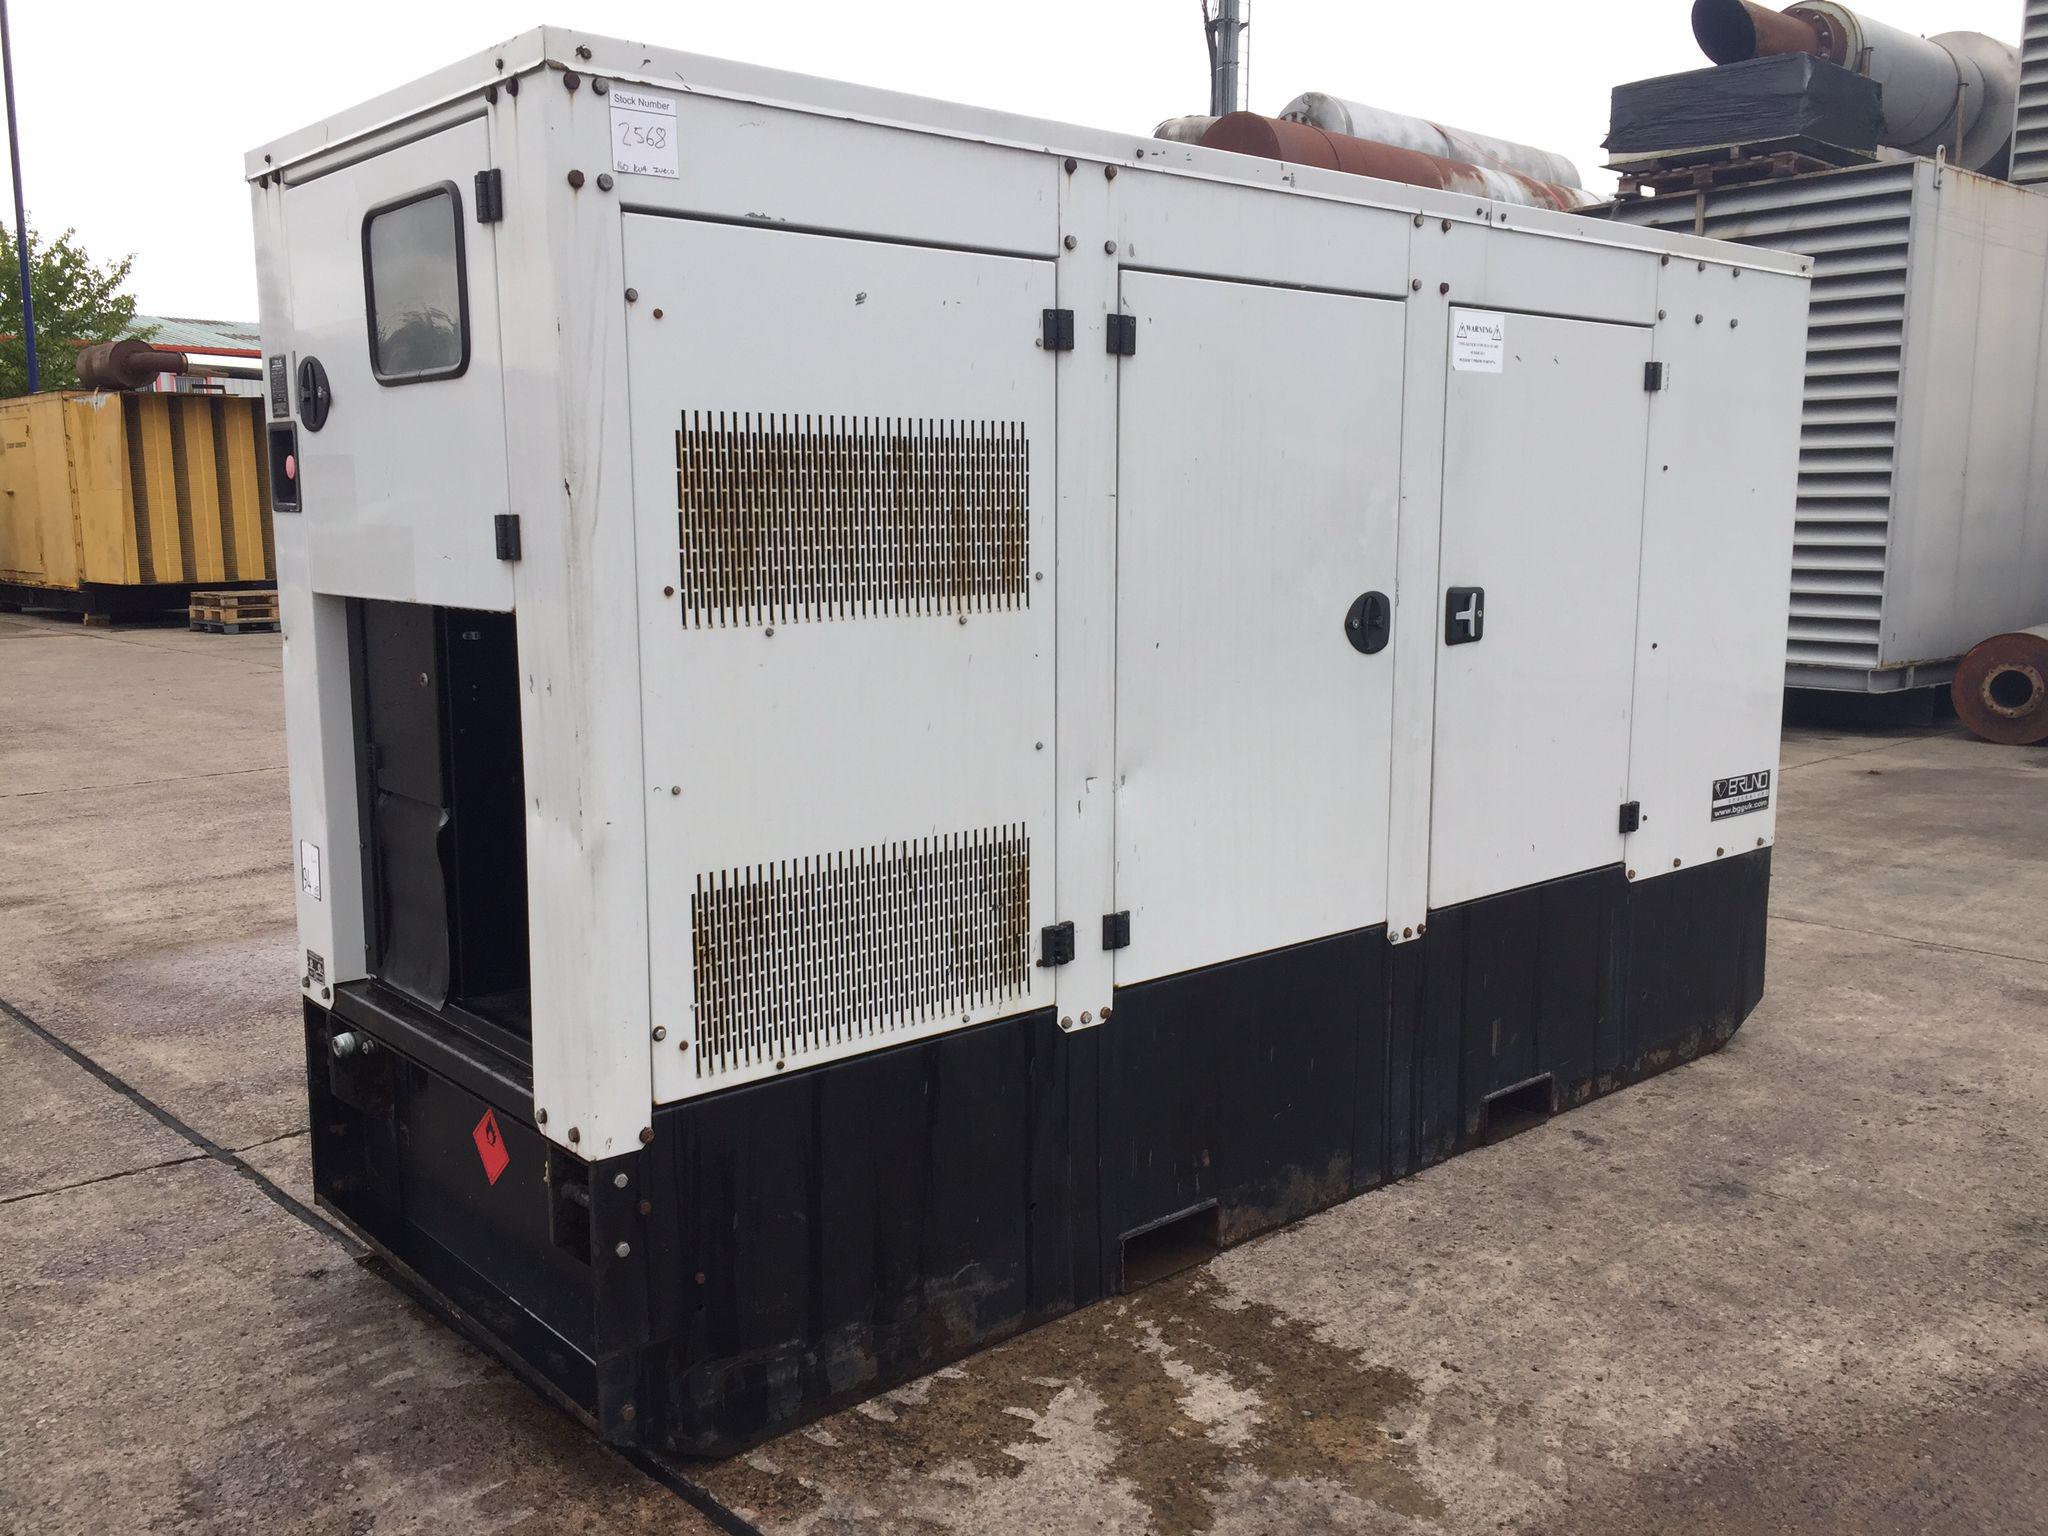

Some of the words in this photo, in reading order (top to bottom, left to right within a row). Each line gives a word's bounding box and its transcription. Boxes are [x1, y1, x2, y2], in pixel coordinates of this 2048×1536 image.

[614, 93, 636, 105] Stock
[638, 97, 670, 110] Number
[618, 121, 666, 149] 2568
[1466, 324, 1493, 334] WARNING
[1728, 772, 1769, 796] BRUNO
